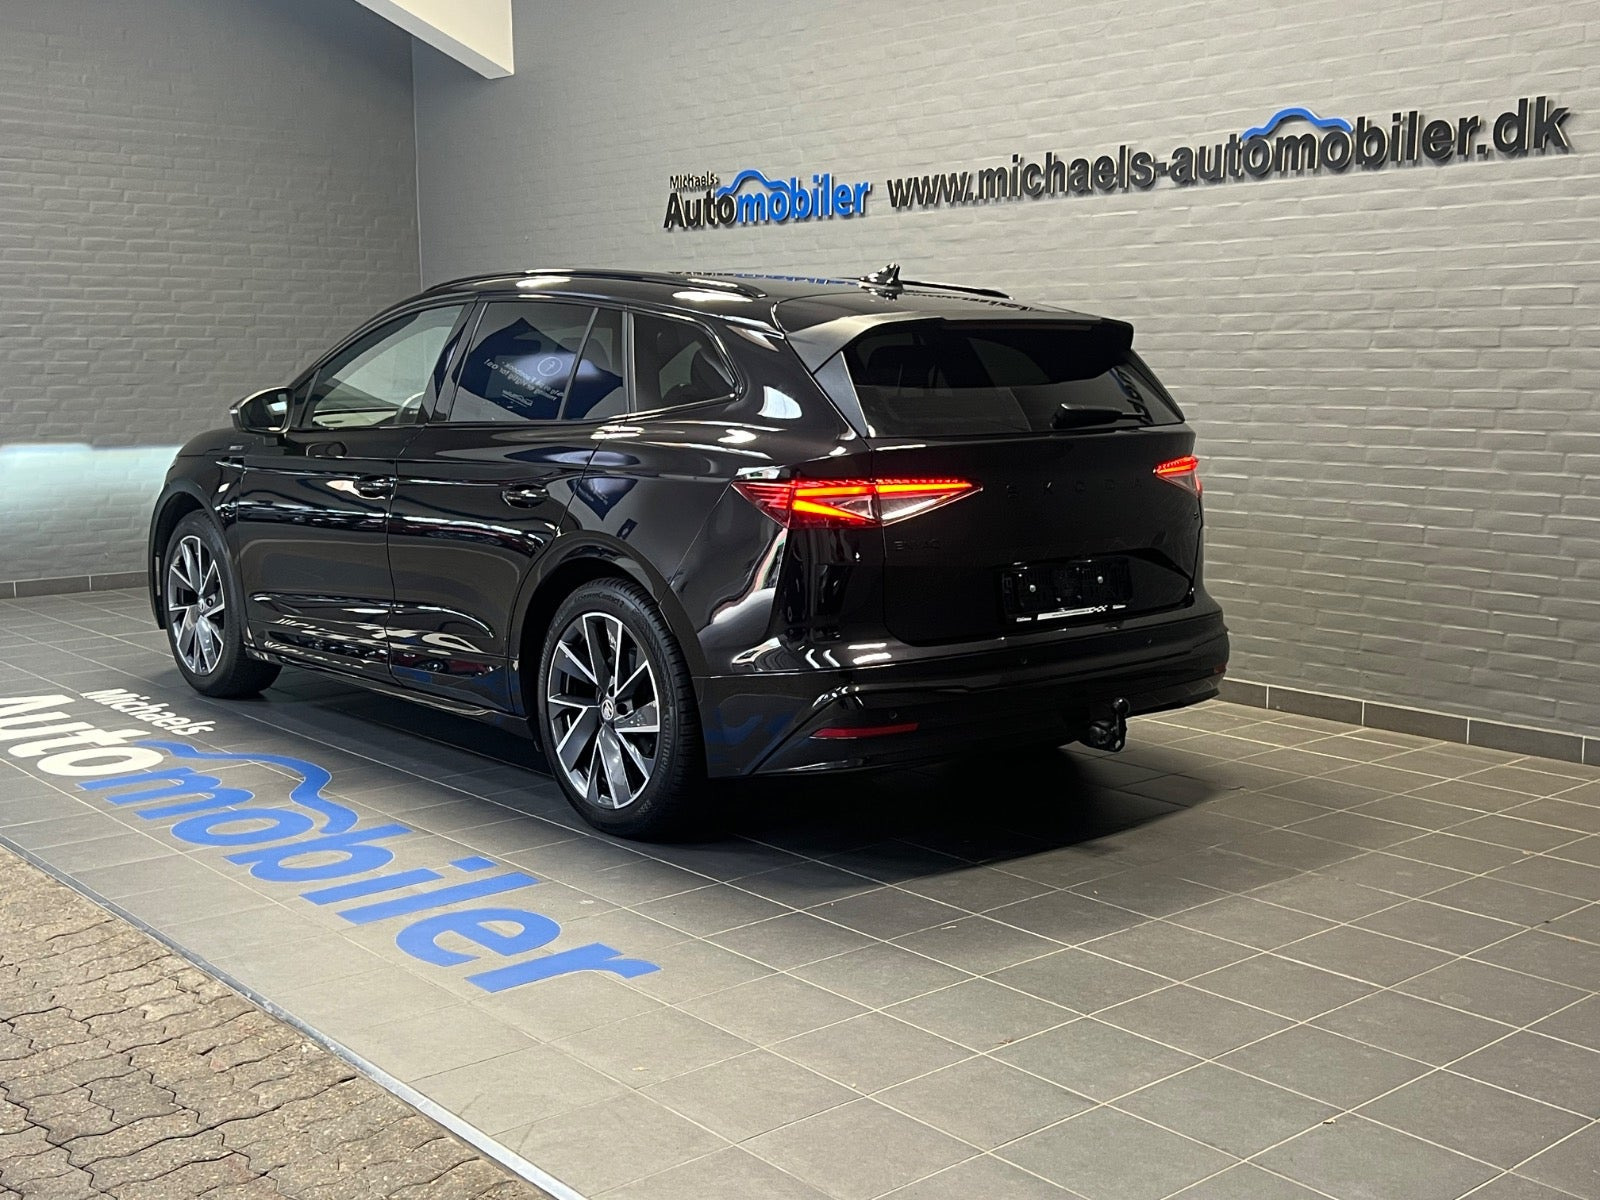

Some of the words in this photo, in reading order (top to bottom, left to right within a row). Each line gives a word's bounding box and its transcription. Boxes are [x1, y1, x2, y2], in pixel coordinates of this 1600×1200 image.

[887, 96, 1571, 208] www.michaels-automobiler.dk
[663, 172, 871, 229] Automobiler
[670, 170, 718, 188] Michaels
[79, 688, 216, 735] Michaels
